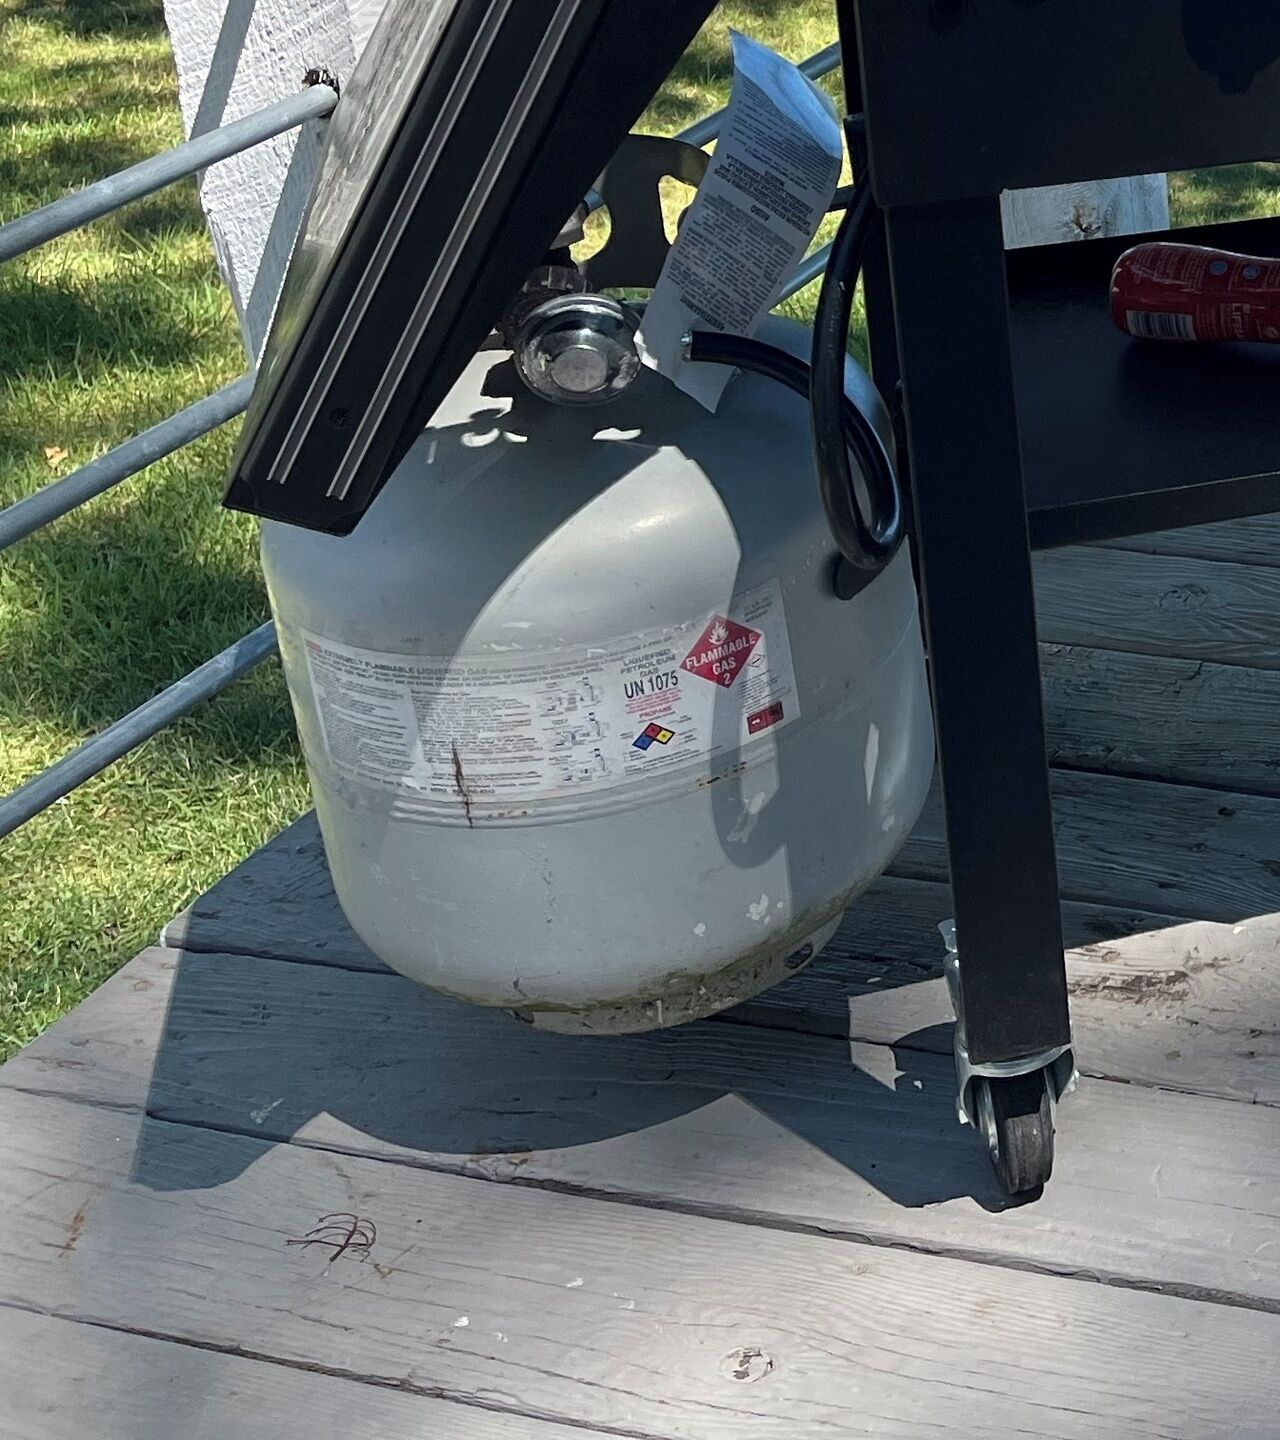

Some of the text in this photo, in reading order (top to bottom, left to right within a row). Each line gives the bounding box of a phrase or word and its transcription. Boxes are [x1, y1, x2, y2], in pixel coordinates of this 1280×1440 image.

[685, 632, 757, 670] FLAMMABLE
[712, 656, 737, 675] GAS
[624, 679, 645, 699] UN
[647, 669, 679, 693] 1075
[723, 672, 731, 685] 2
